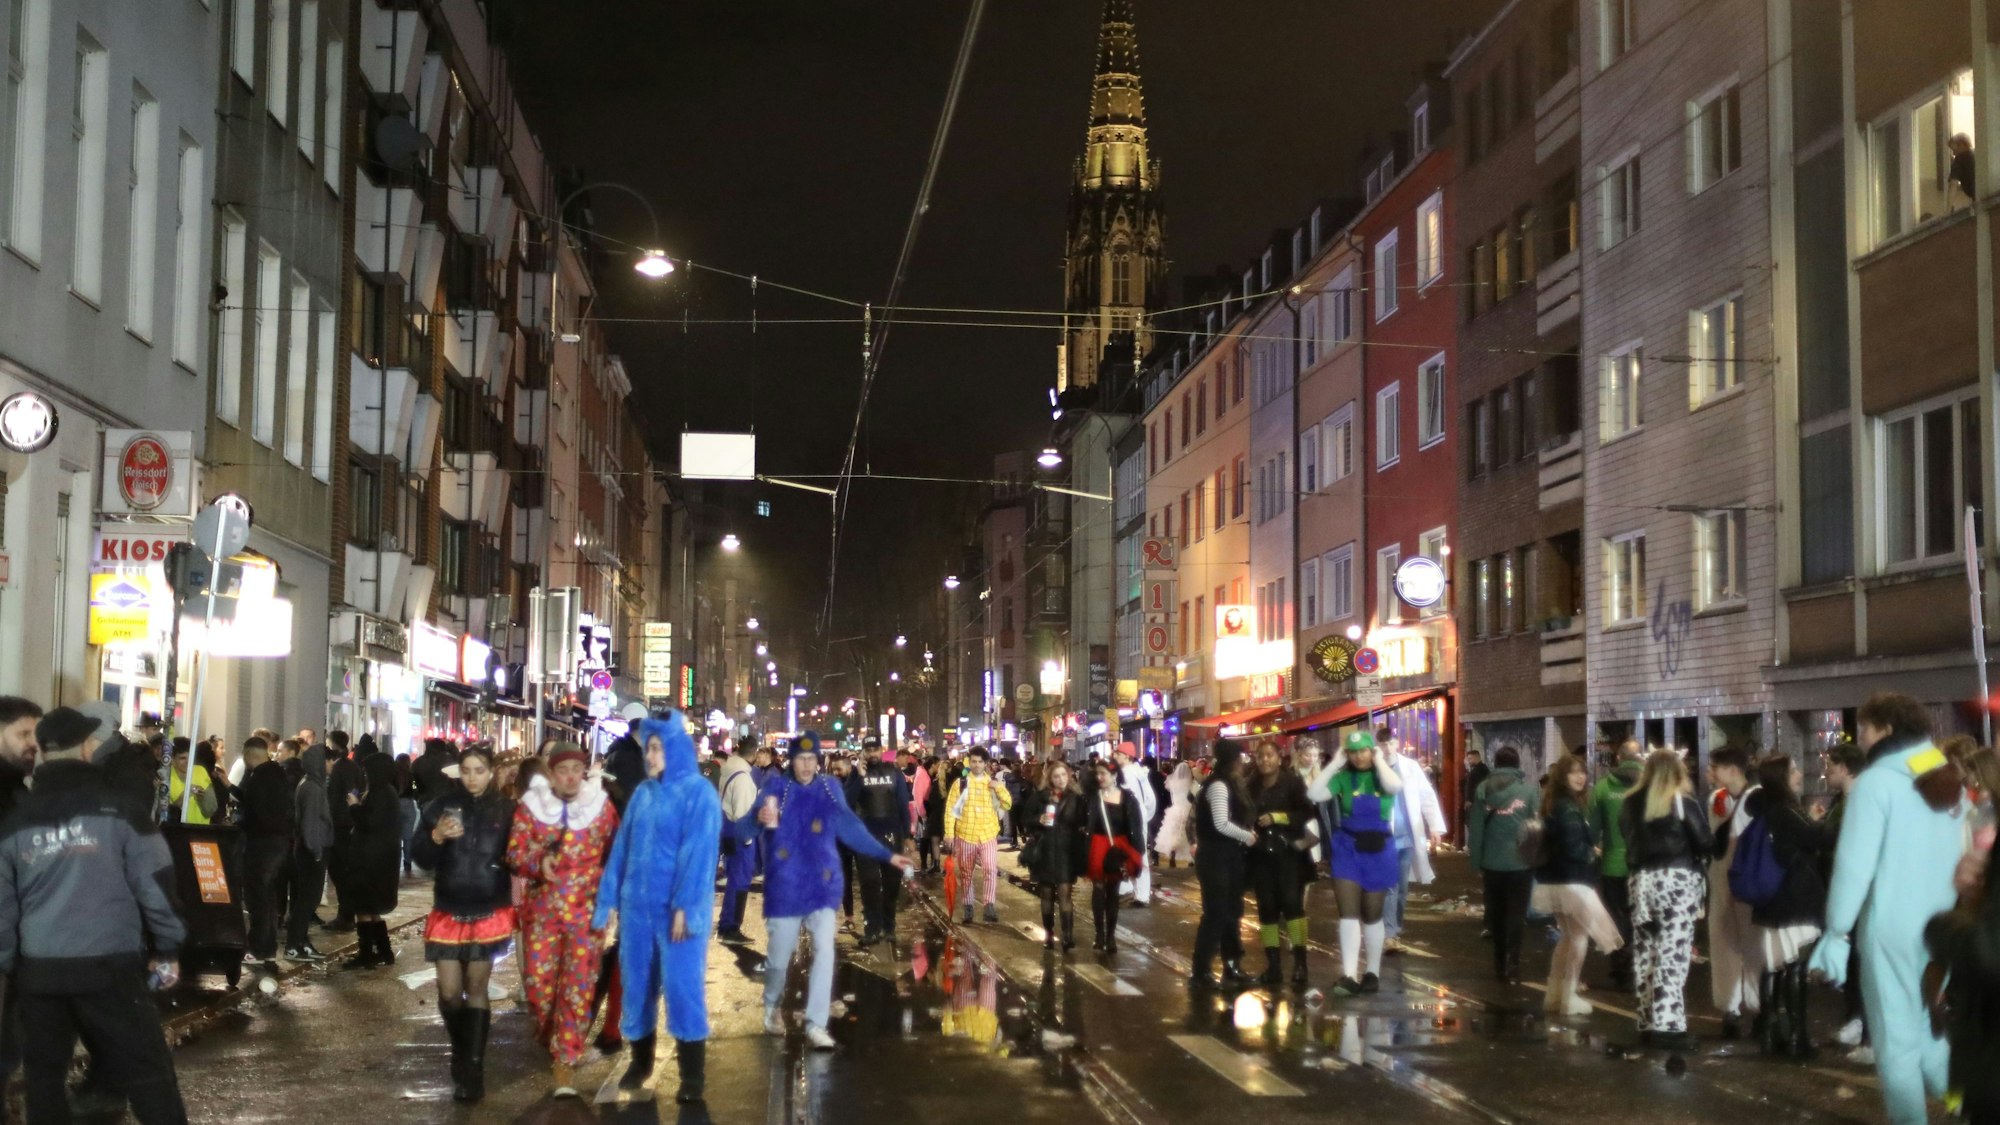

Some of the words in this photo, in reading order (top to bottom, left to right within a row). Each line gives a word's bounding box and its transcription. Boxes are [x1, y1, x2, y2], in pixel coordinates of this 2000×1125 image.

[124, 466, 166, 477] Reissdorf
[863, 776, 892, 786] S.W.A.T.
[193, 844, 211, 855] Glas
